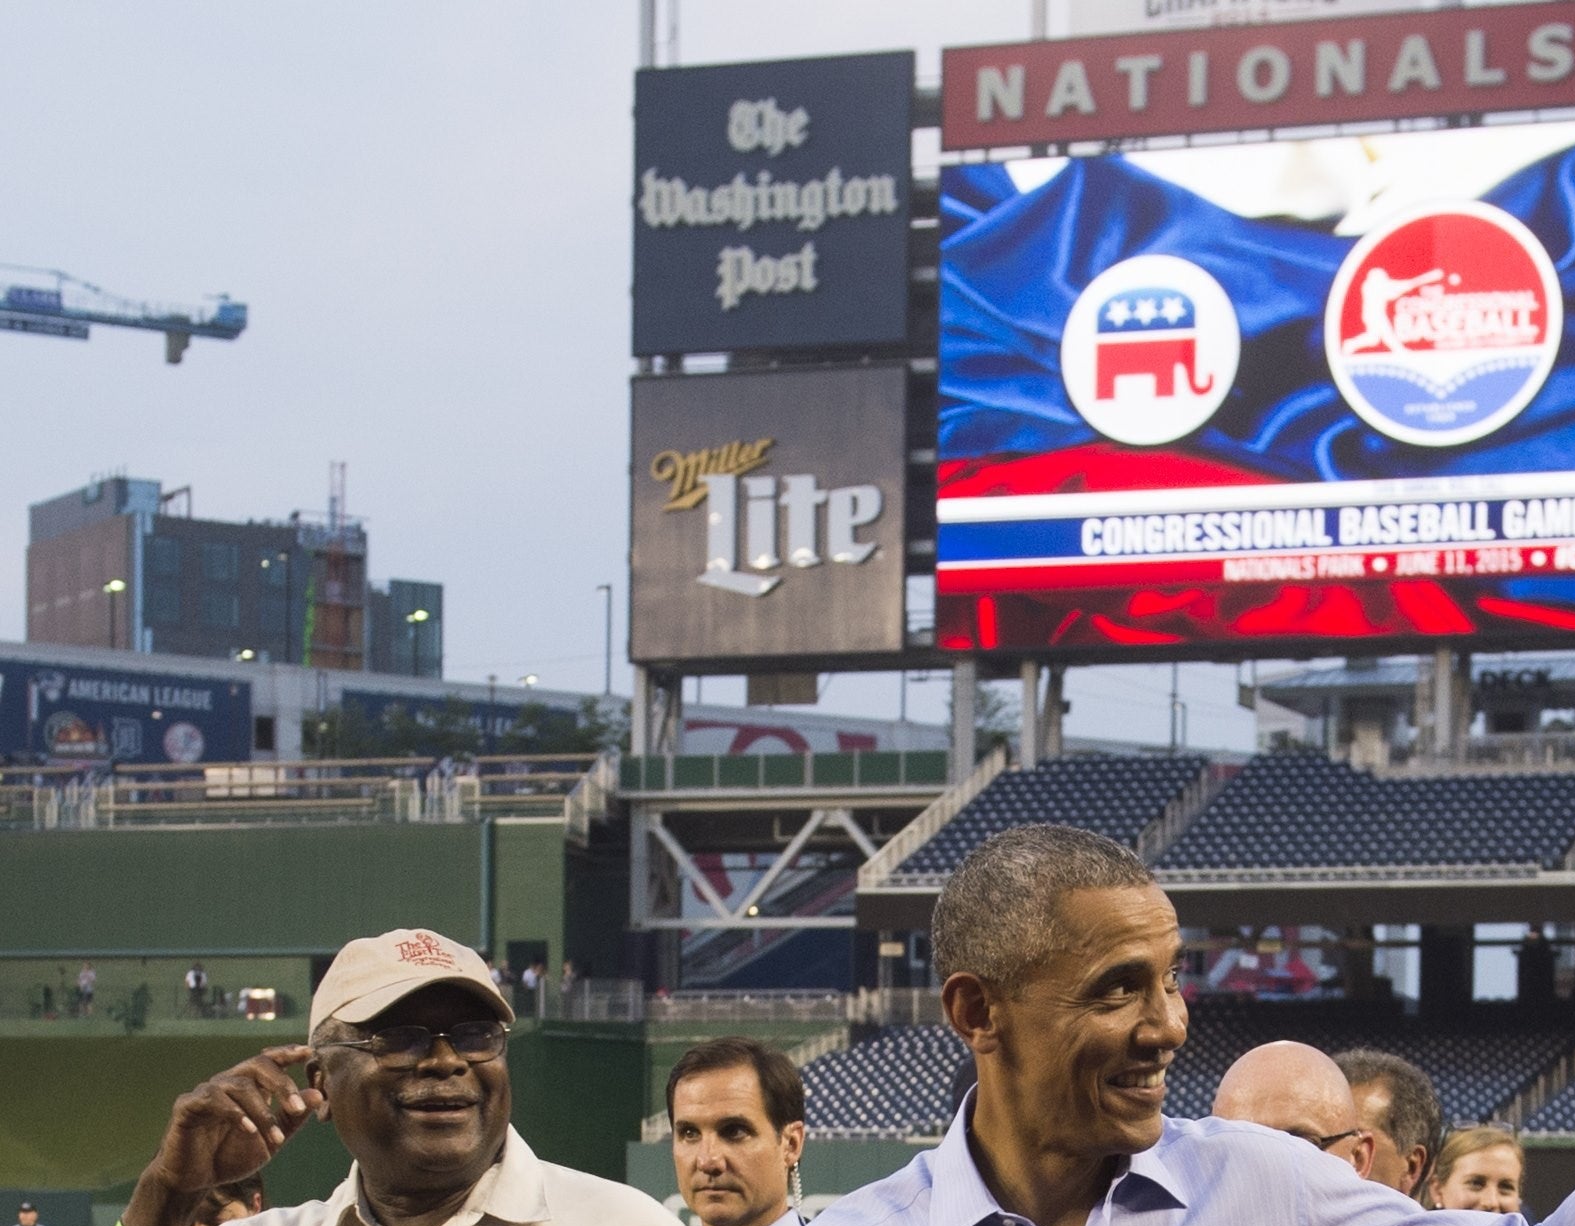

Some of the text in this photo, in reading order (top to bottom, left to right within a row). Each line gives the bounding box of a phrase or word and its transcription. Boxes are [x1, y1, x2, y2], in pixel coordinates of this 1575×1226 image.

[976, 23, 1575, 122] NATIONALS
[728, 97, 809, 157] The
[638, 166, 899, 231] Washington
[714, 241, 819, 311] Post
[1394, 308, 1541, 342] BASEBALL
[650, 437, 775, 512] Miller
[697, 472, 884, 597] Lite
[1080, 507, 1333, 556] CONGRESSIONAL
[1338, 500, 1497, 546] BASEBALL
[1223, 555, 1317, 582] NATIONALS
[1318, 552, 1365, 578] PARK
[1395, 549, 1440, 576] JUNE
[1475, 546, 1523, 573] 2015
[67, 677, 213, 712] AMERICAN LEAGUE
[1480, 667, 1552, 690] DECK
